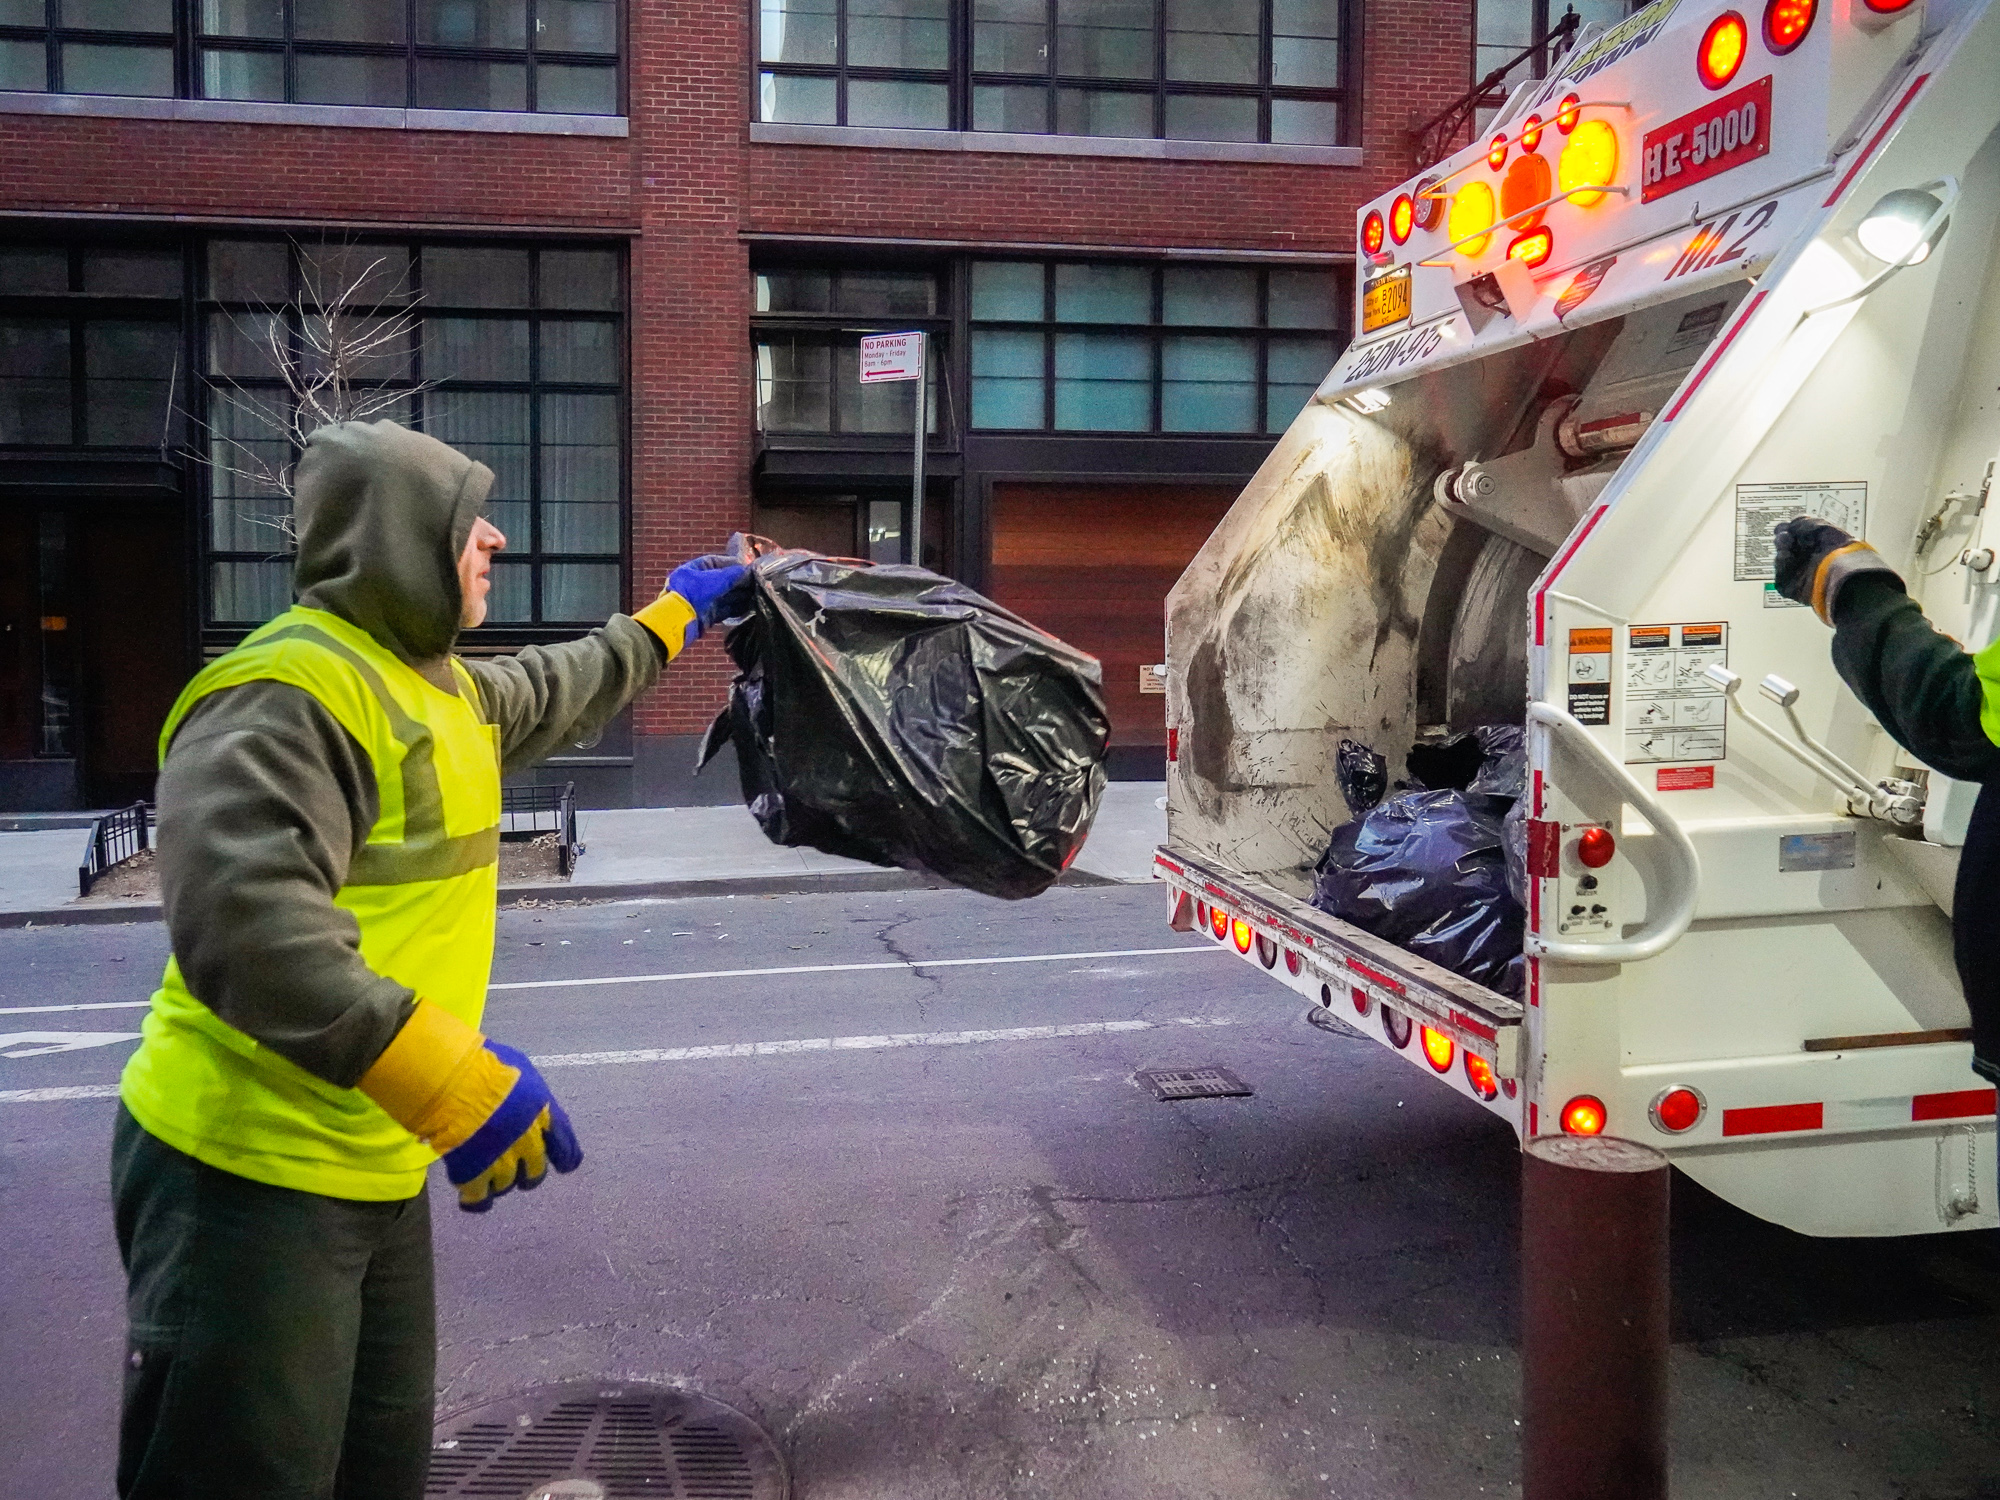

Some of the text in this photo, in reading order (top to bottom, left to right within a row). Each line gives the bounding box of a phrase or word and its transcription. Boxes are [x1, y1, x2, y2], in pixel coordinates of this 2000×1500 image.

[1643, 101, 1757, 186] HE-5000
[1663, 200, 1779, 282] M.2
[1387, 280, 1408, 313] 2094
[876, 338, 906, 348] PARKING
